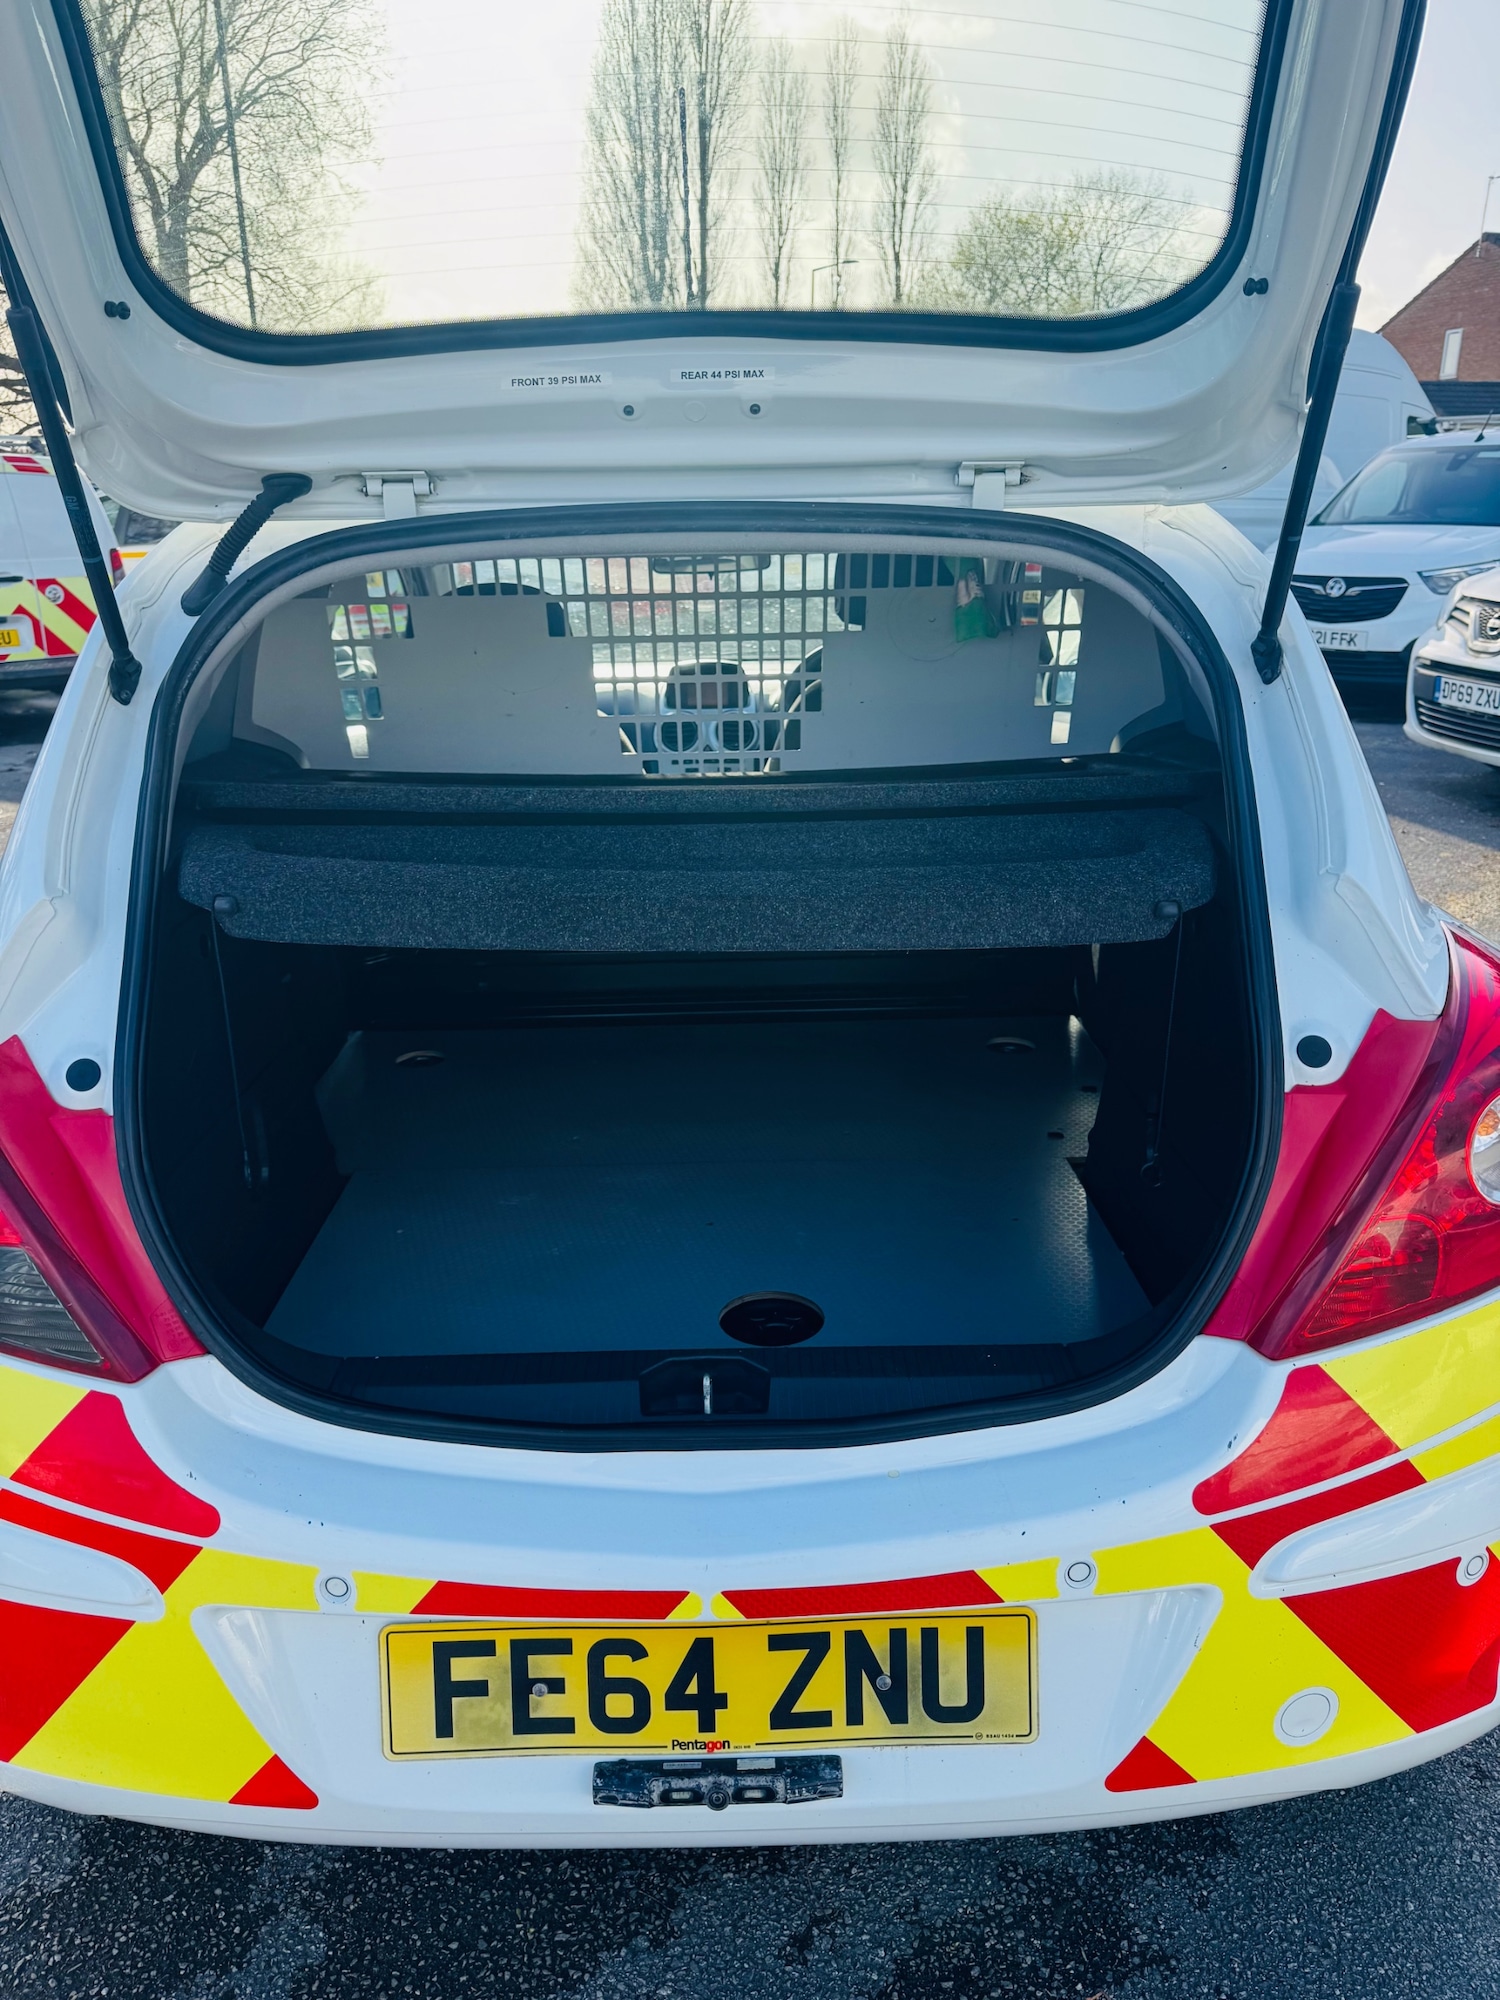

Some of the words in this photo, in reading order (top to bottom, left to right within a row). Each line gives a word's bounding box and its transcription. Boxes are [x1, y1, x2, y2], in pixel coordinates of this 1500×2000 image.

[511, 376, 545, 387] FRONT
[547, 376, 559, 386] 39
[561, 375, 578, 385] PSI
[580, 374, 602, 385] MAX
[680, 371, 708, 380] REAR
[710, 370, 722, 380] 44
[724, 370, 741, 379] PSI
[743, 369, 765, 379] MAX
[65, 495, 80, 511] GM
[1311, 630, 1326, 644] 21
[1330, 631, 1358, 646] FFK
[1442, 681, 1473, 703] DP69
[1475, 688, 1500, 709] ZXU
[433, 1636, 729, 1739] FE64
[768, 1626, 986, 1731] ZNU
[671, 1739, 731, 1754] Pentagon
